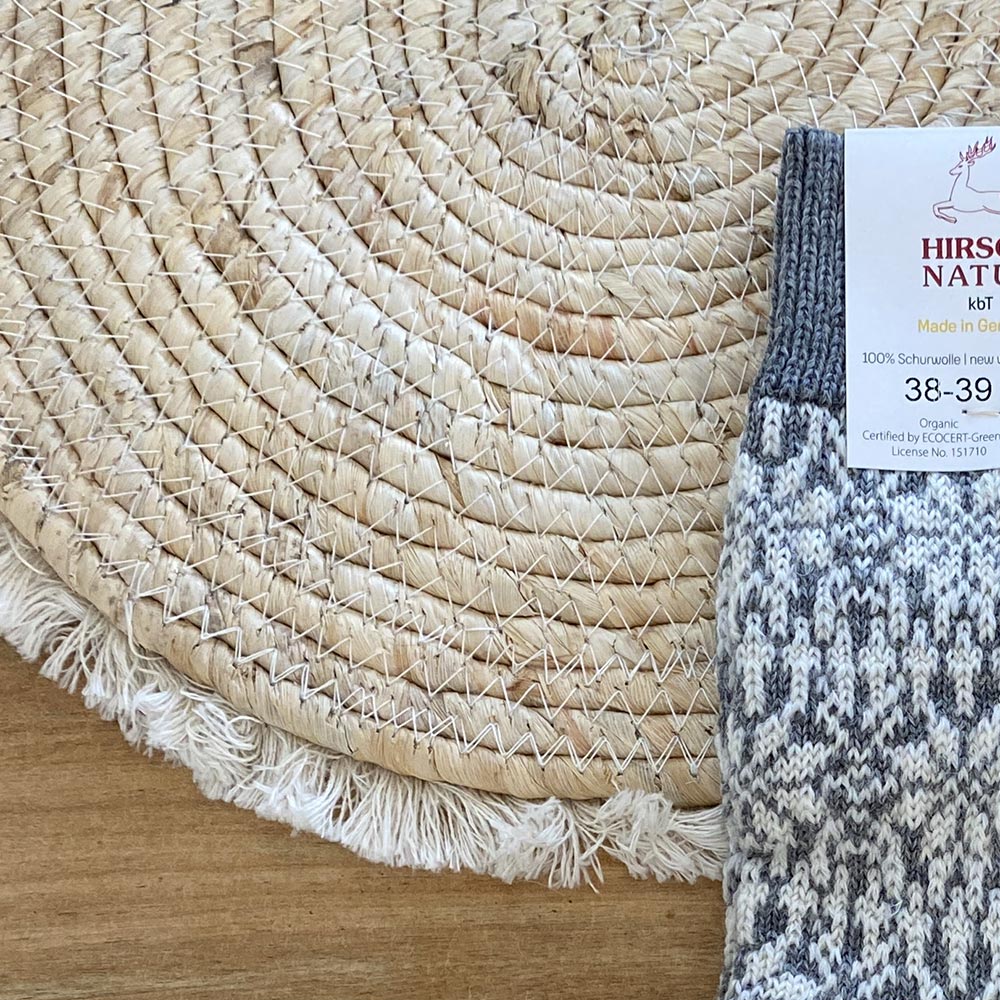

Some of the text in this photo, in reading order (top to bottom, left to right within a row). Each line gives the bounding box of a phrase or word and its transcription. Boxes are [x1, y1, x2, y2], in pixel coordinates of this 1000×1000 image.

[968, 297, 993, 310] kbT
[918, 320, 956, 333] Made
[961, 320, 973, 332] in
[862, 352, 895, 365] 100%
[898, 353, 961, 366] Schurwolle
[970, 356, 994, 365] new
[905, 377, 992, 402] 38-39
[919, 418, 959, 429] Organic
[862, 431, 905, 442] Certified
[907, 433, 920, 444] by
[891, 447, 987, 458] License No. 151710
